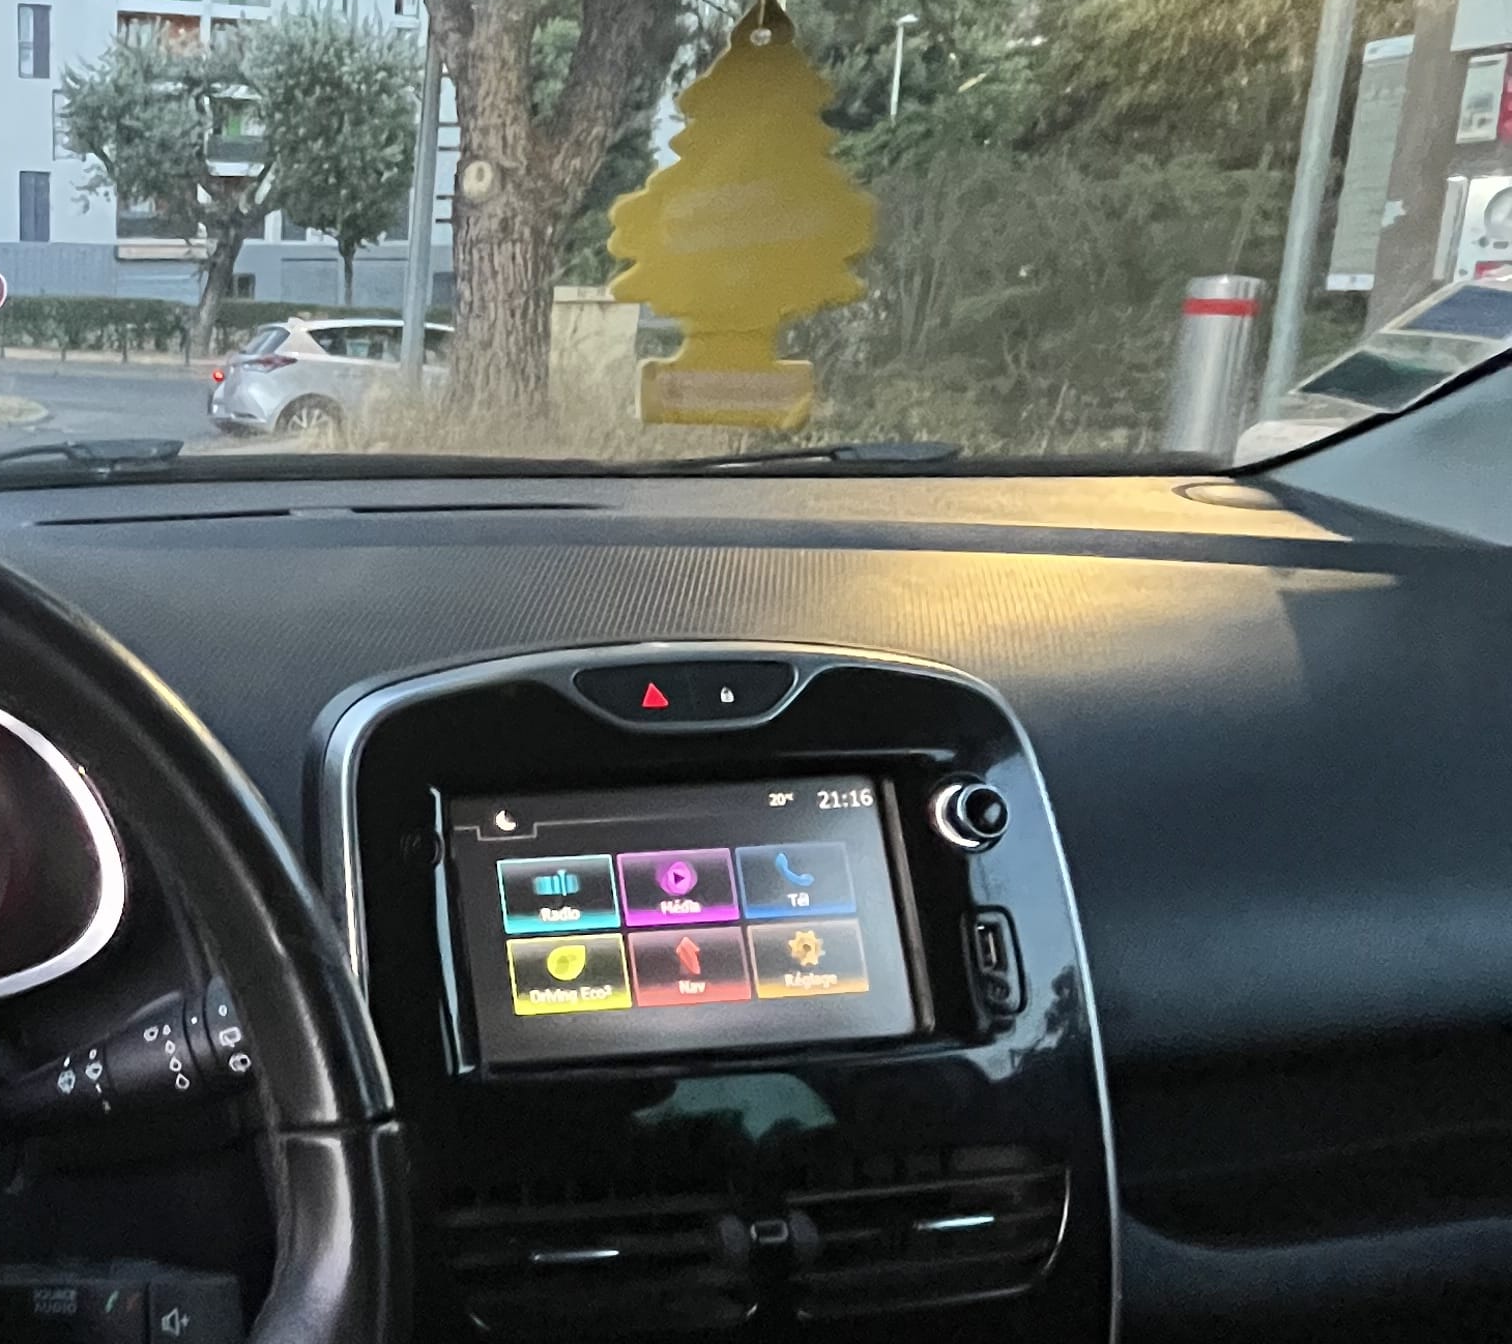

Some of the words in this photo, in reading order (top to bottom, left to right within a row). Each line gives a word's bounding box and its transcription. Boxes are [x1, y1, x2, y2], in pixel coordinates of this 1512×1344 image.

[816, 788, 874, 810] 21:16
[539, 906, 581, 922] Radio
[660, 899, 702, 914] Média
[678, 980, 706, 995] Nav
[529, 987, 578, 1005] Driving
